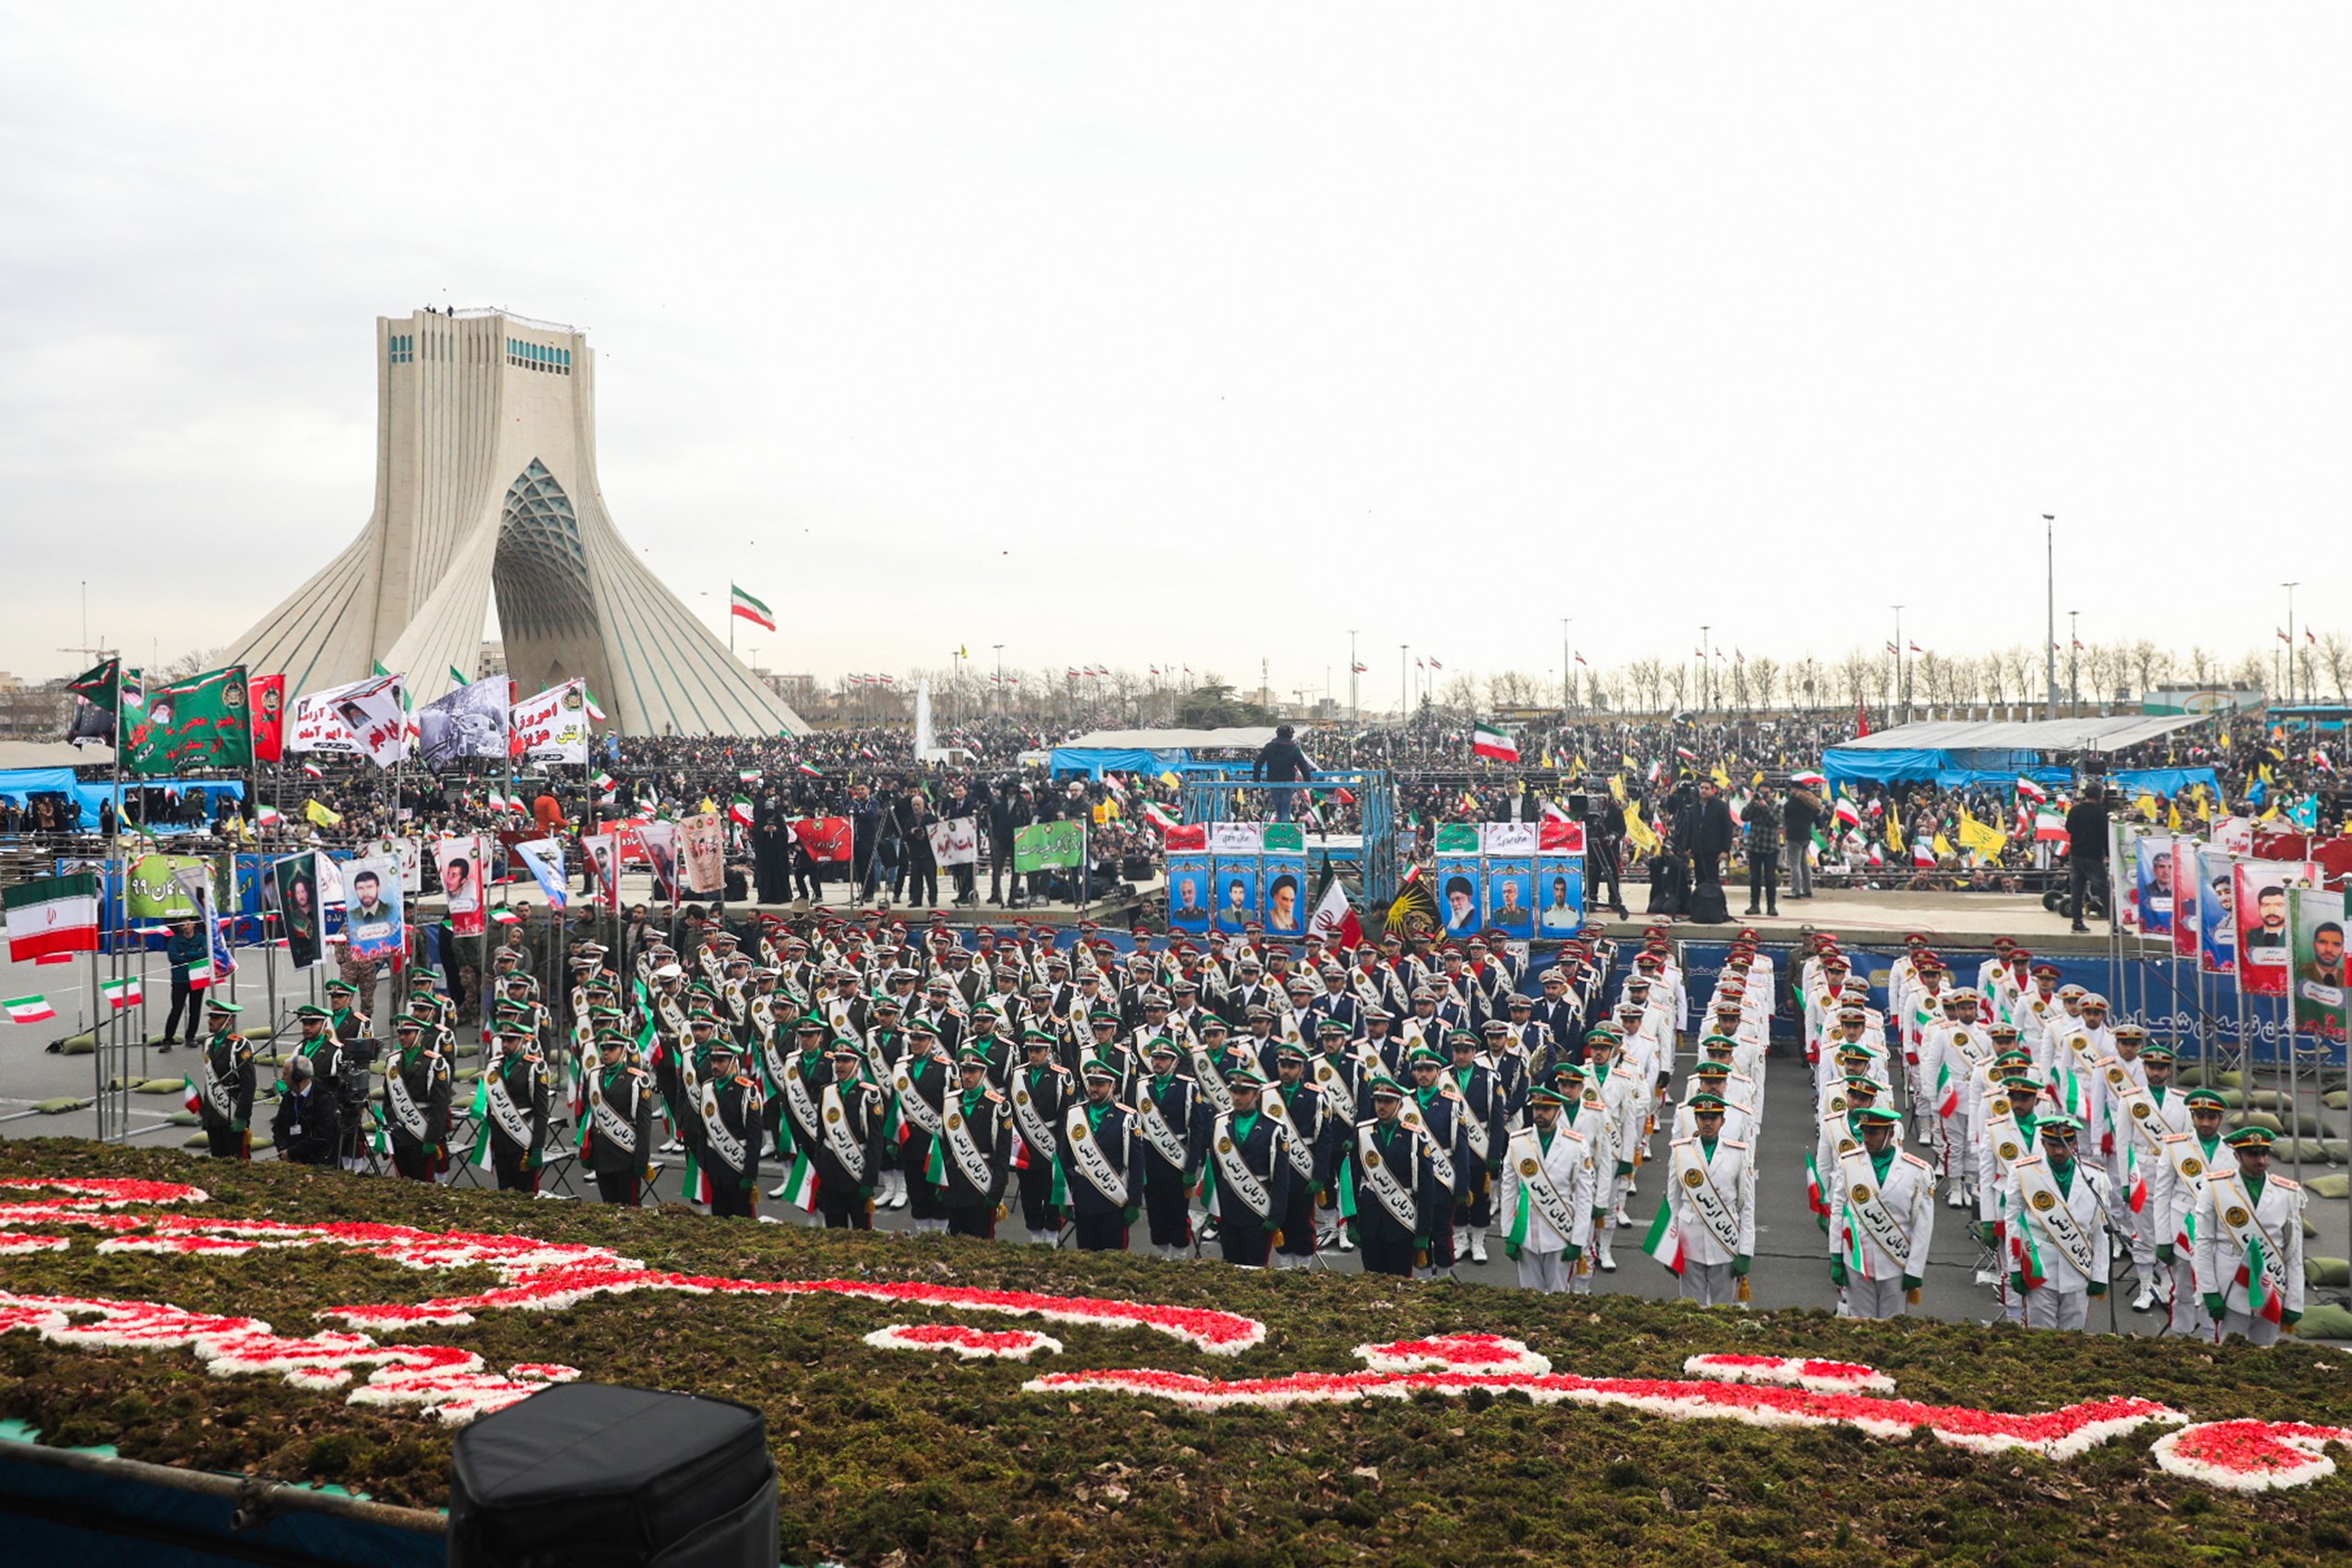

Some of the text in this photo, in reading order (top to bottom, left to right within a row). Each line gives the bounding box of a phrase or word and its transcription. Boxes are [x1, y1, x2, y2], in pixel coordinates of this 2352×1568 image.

[518, 702, 558, 731] امروز
[132, 878, 148, 896] ۹۹
[391, 1081, 421, 1127] دژبان ارتش
[790, 1081, 809, 1109] ارتش
[904, 1093, 927, 1114] ارتش
[1201, 1073, 1223, 1097] ارتش
[1326, 1083, 1348, 1108] ارتش
[491, 1087, 522, 1134] دژبان ارتش
[596, 1110, 619, 1131] ارتش
[1021, 1109, 1055, 1153] دژبان ارتش
[710, 1122, 732, 1148] ارتش
[832, 1126, 855, 1154] ارتش
[1148, 1113, 1182, 1161] دژبان ارتش
[1290, 1144, 1311, 1170] دژبان
[954, 1133, 989, 1184] دژبان ارتش
[1079, 1141, 1118, 1194] دژبان ارتش
[1432, 1156, 1453, 1179] دژبان
[1226, 1158, 1266, 1206] دژبان ارتش
[1373, 1170, 1416, 1221] دژبان ارتش
[1530, 1179, 1574, 1234] دژبان ارتش
[1696, 1191, 1739, 1246] دژبان ارتش
[1864, 1207, 1910, 1259] دژبان ارتش
[2049, 1214, 2093, 1268] دژبان ارتش
